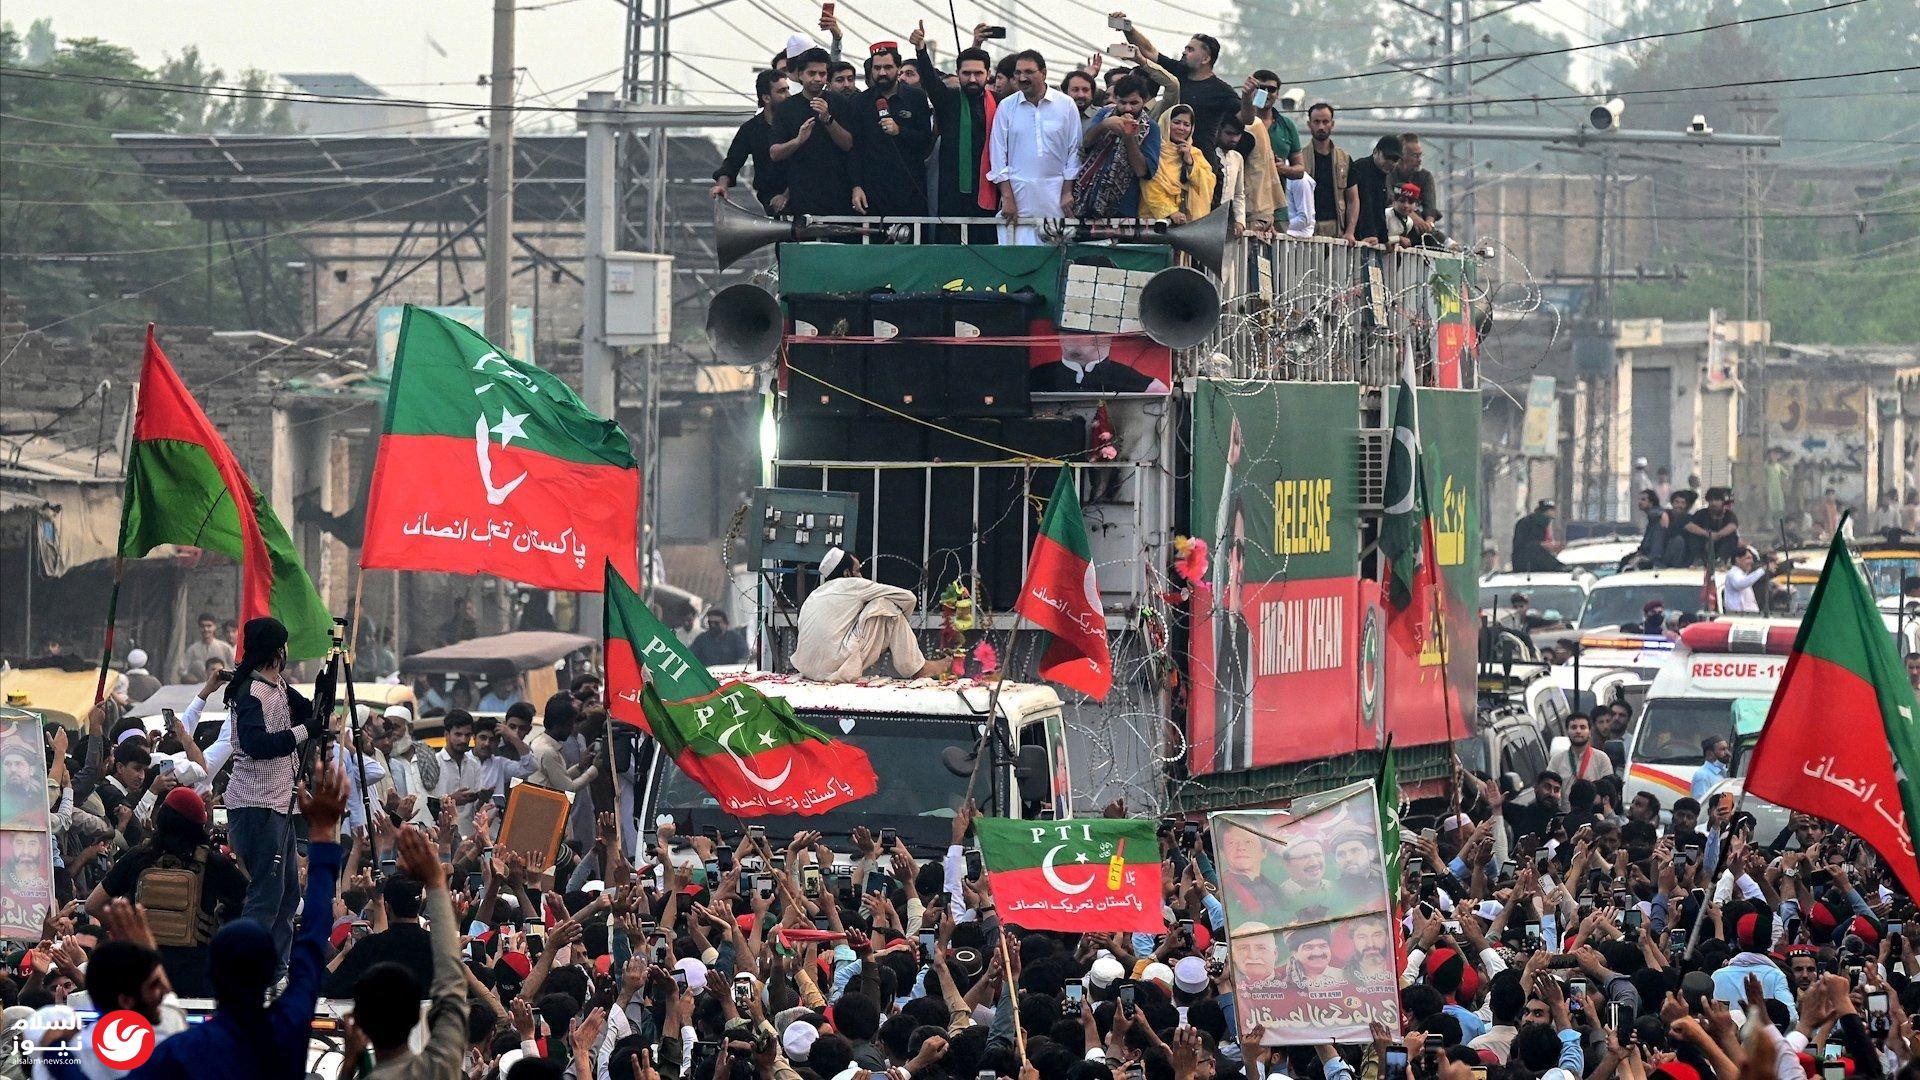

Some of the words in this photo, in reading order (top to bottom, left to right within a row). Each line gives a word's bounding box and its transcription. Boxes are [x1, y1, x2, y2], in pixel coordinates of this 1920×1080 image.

[402, 512, 469, 541] انصاف
[1274, 478, 1332, 555] RELEASE
[1032, 587, 1068, 613] انصاف
[1258, 600, 1304, 676] IMRAN
[1306, 596, 1344, 671] KHAN
[641, 634, 691, 683] PTI
[1692, 663, 1785, 678] RESCUE-11
[693, 690, 749, 731] PT
[801, 776, 854, 809] پاکستان
[1803, 755, 1878, 803] انصاف
[1030, 824, 1093, 844] PTI
[1008, 899, 1049, 911] انصاف
[1050, 897, 1094, 914] تحریک
[1096, 893, 1143, 912] پاکستان
